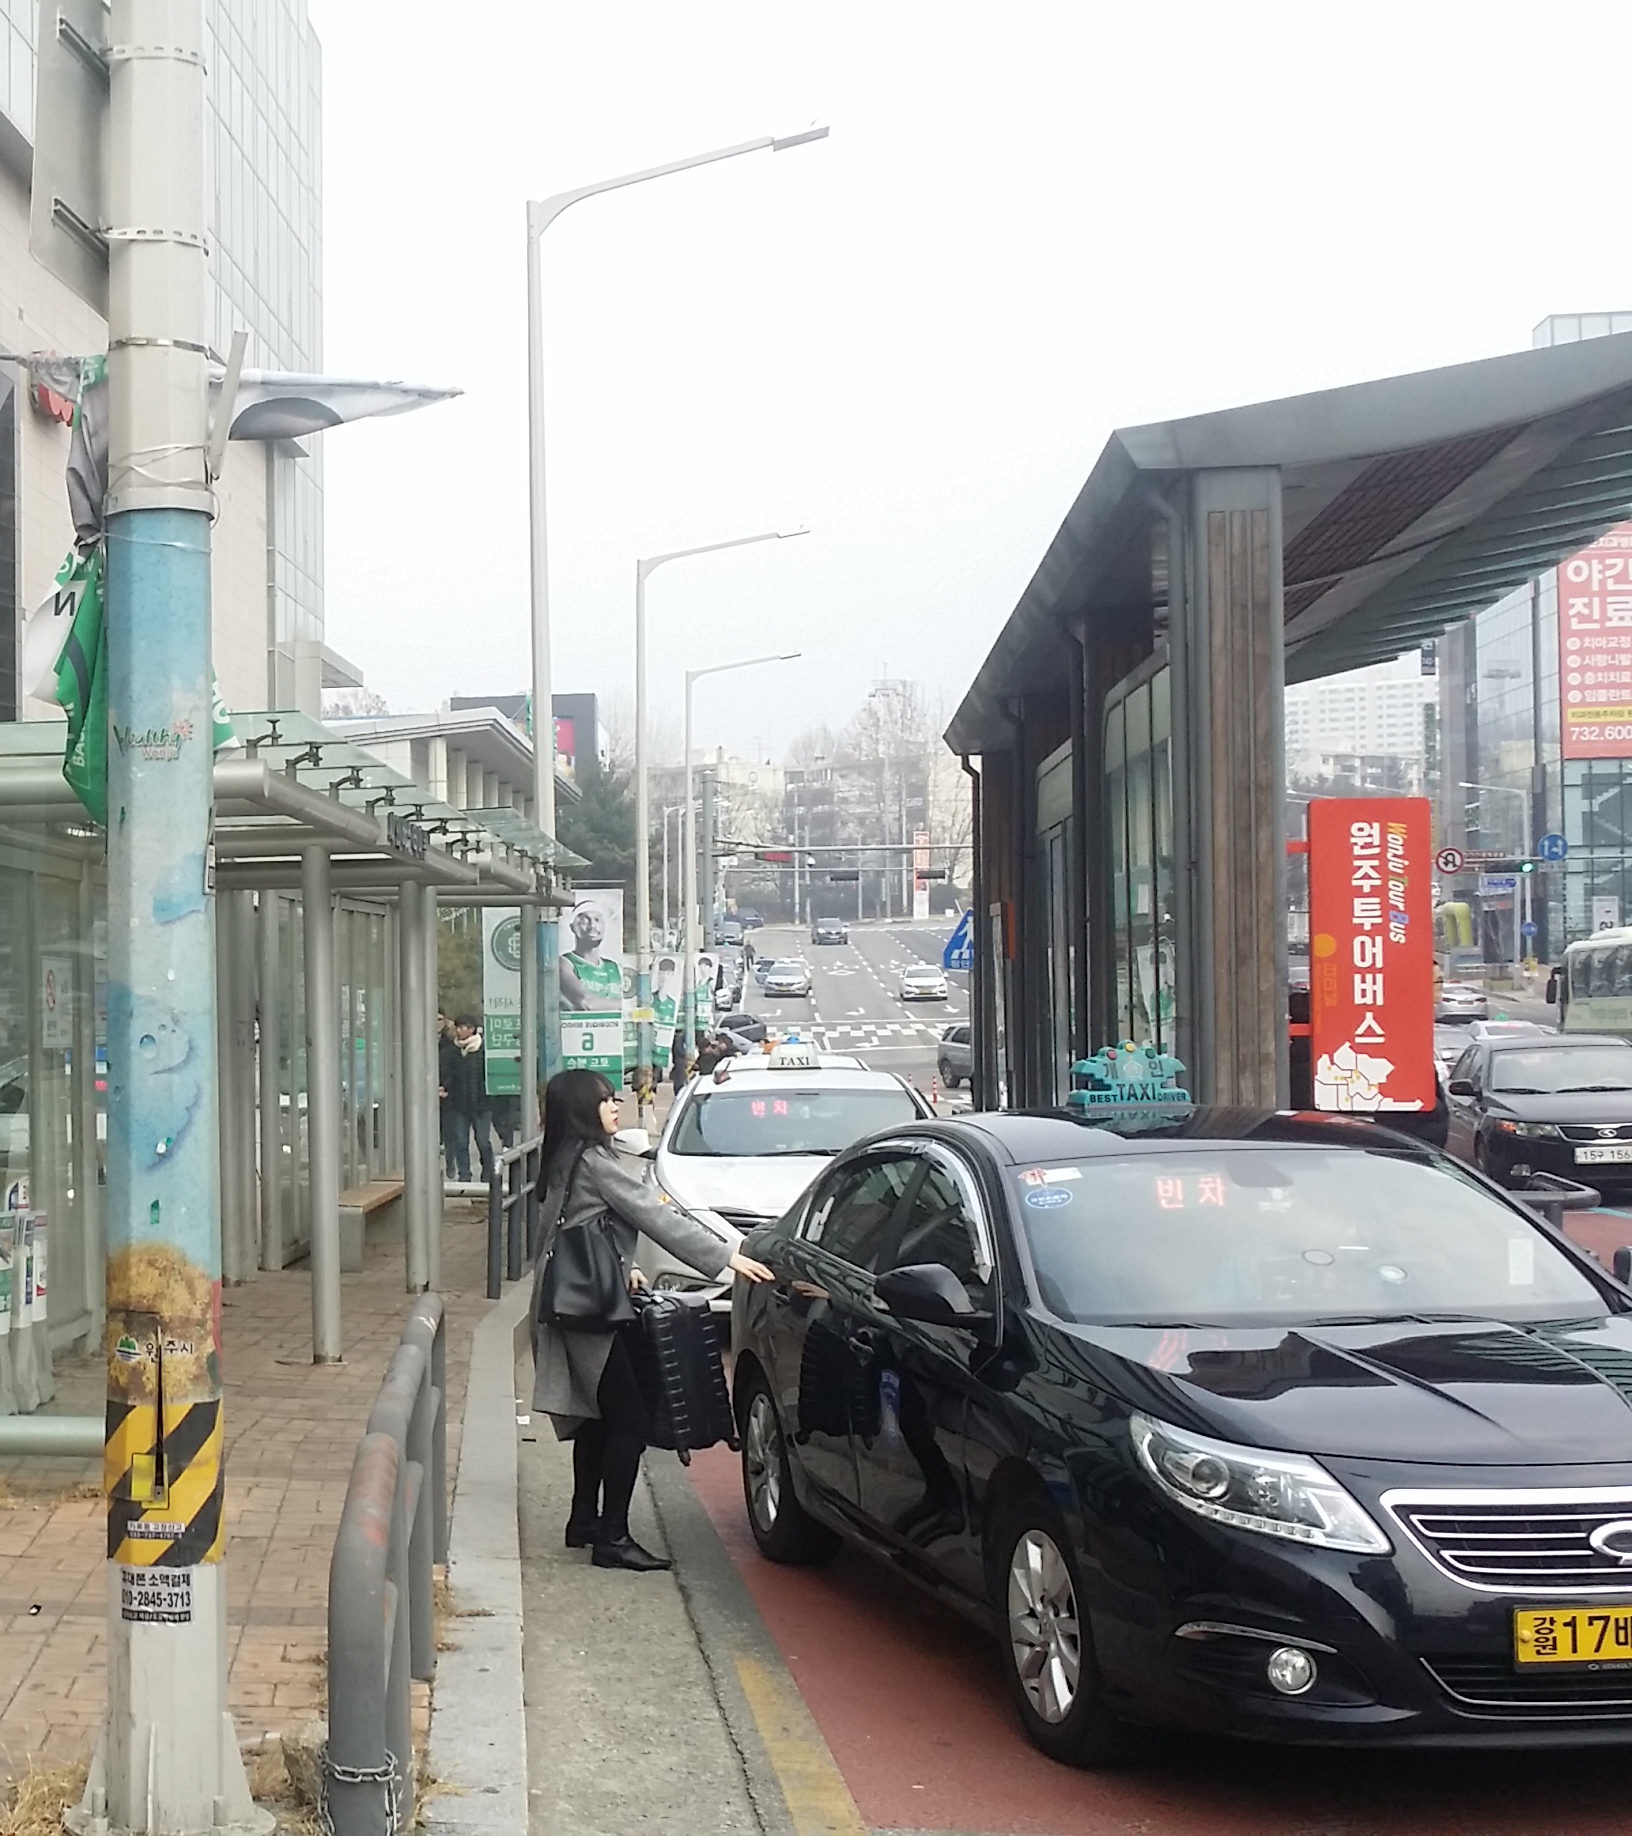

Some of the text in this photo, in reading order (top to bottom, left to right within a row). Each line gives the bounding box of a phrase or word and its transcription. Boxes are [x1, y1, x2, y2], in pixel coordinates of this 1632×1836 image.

[1567, 558, 1632, 591] 야간
[1568, 596, 1632, 629] 진료
[1387, 822, 1409, 944] Wonju Tour Bus
[1349, 821, 1386, 1044] 원주투어버스
[779, 1056, 810, 1066] TAXI
[1089, 1083, 1186, 1103] BEST TAXI DRIVER
[1533, 1616, 1558, 1656] 강원
